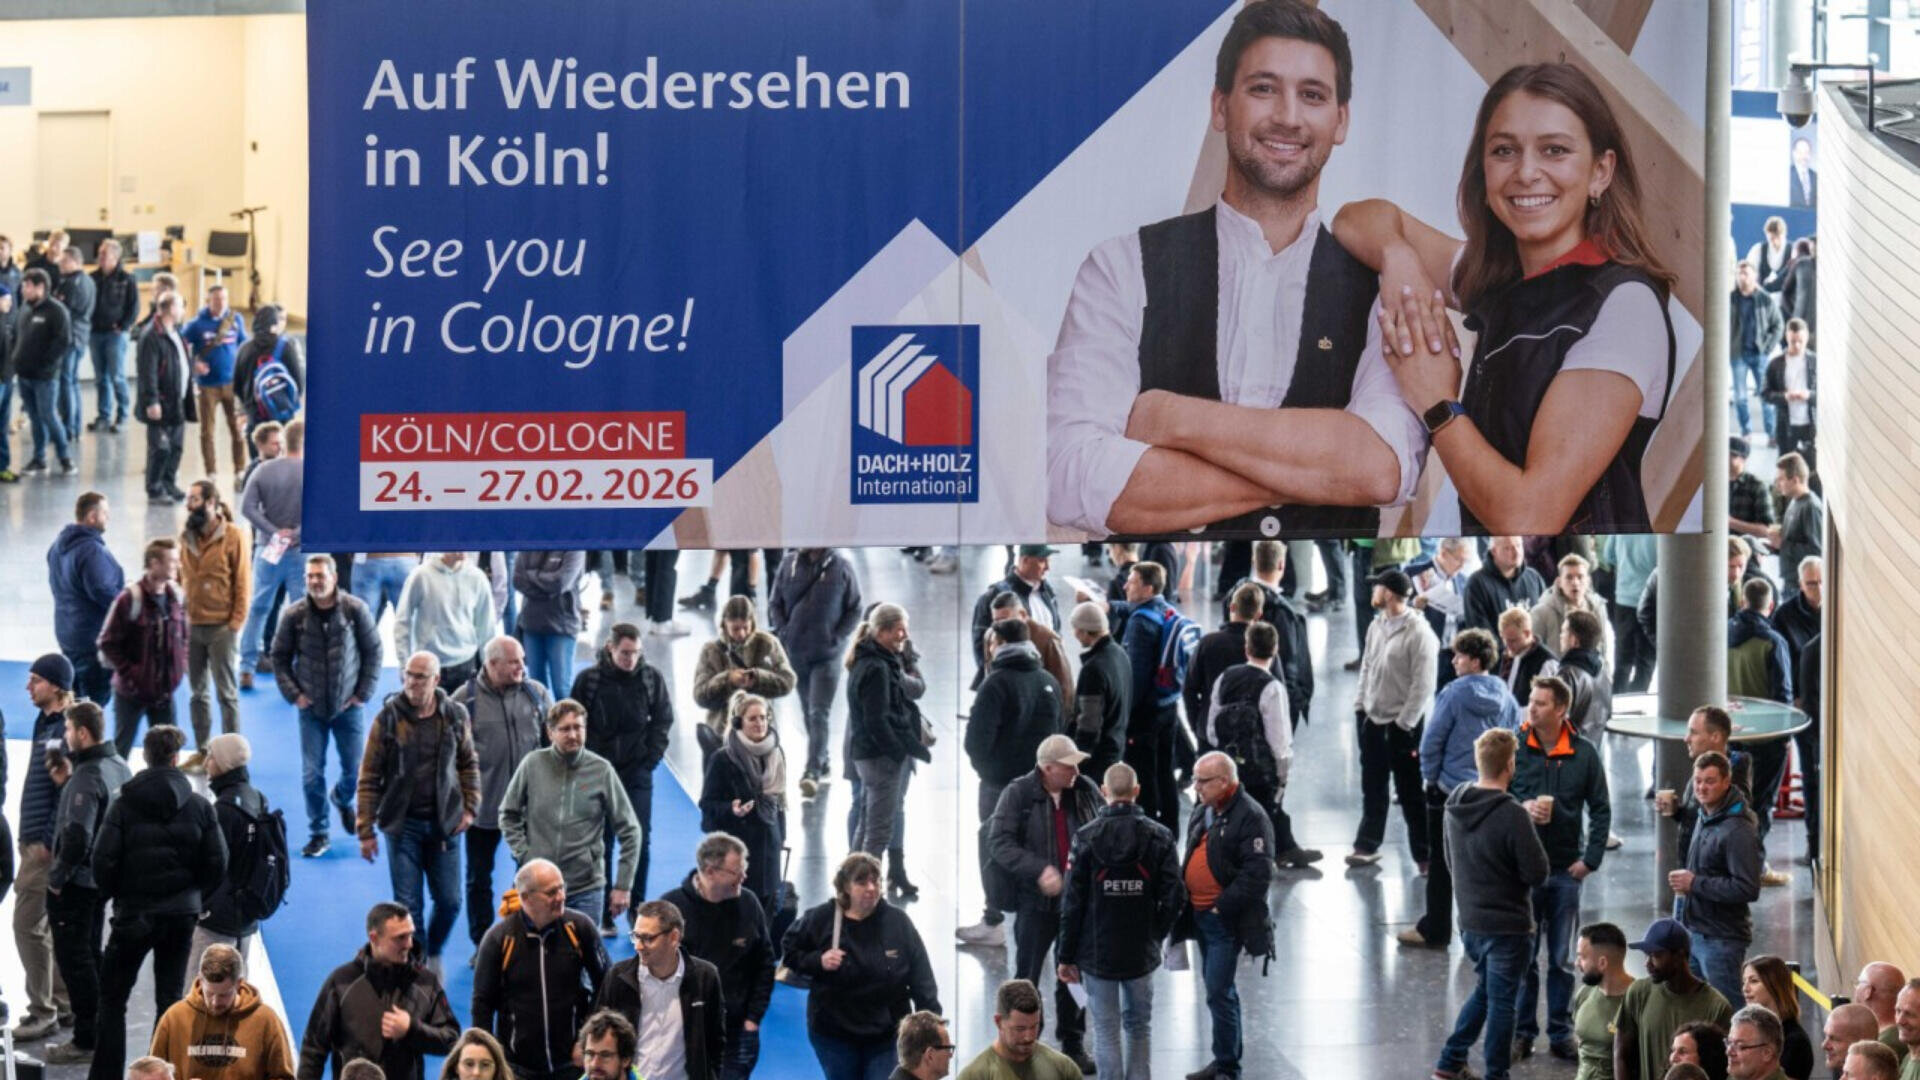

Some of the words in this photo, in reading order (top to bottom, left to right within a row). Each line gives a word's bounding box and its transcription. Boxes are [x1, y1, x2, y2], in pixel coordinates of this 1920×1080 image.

[362, 56, 476, 111] Auf
[494, 55, 911, 110] Wiedersehen
[365, 134, 420, 186] in
[448, 131, 609, 186] Köln!
[365, 225, 463, 278] See
[482, 238, 586, 293] you
[364, 301, 415, 354] in
[440, 297, 694, 369] Cologne!
[372, 417, 675, 455] KÖLN/COLOGNE
[857, 453, 972, 474] DACH+HOLZ
[374, 470, 433, 503] 24.
[857, 475, 972, 495] International
[1103, 879, 1144, 892] PETER
